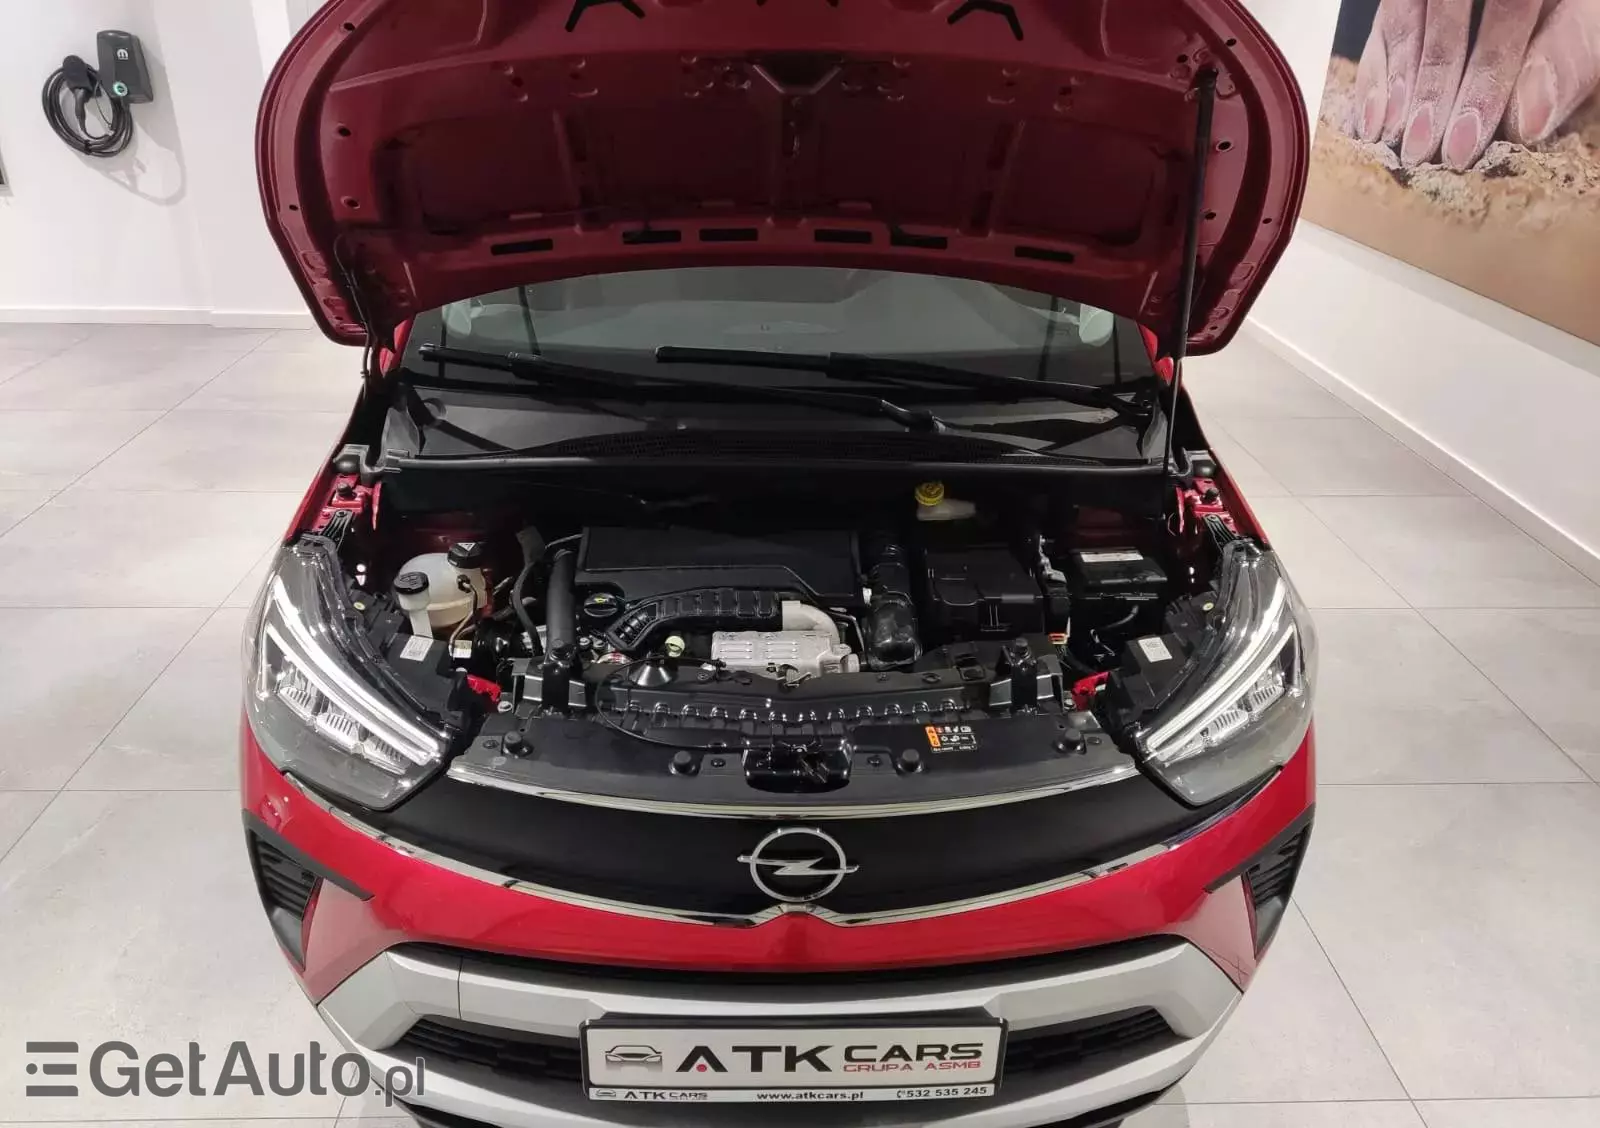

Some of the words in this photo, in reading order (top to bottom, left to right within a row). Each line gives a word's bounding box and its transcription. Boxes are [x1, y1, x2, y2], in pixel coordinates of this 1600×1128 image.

[675, 1045, 834, 1073] ATK
[844, 1043, 984, 1062] CARS
[843, 1062, 913, 1072] GRUPA
[925, 1060, 981, 1070] ASMB
[624, 1091, 666, 1100] ATK
[669, 1092, 708, 1100] CARS
[757, 1091, 864, 1102] www.atkcars.pl
[906, 1089, 930, 1098] 532
[935, 1088, 959, 1097] 535
[963, 1086, 987, 1096] 245
